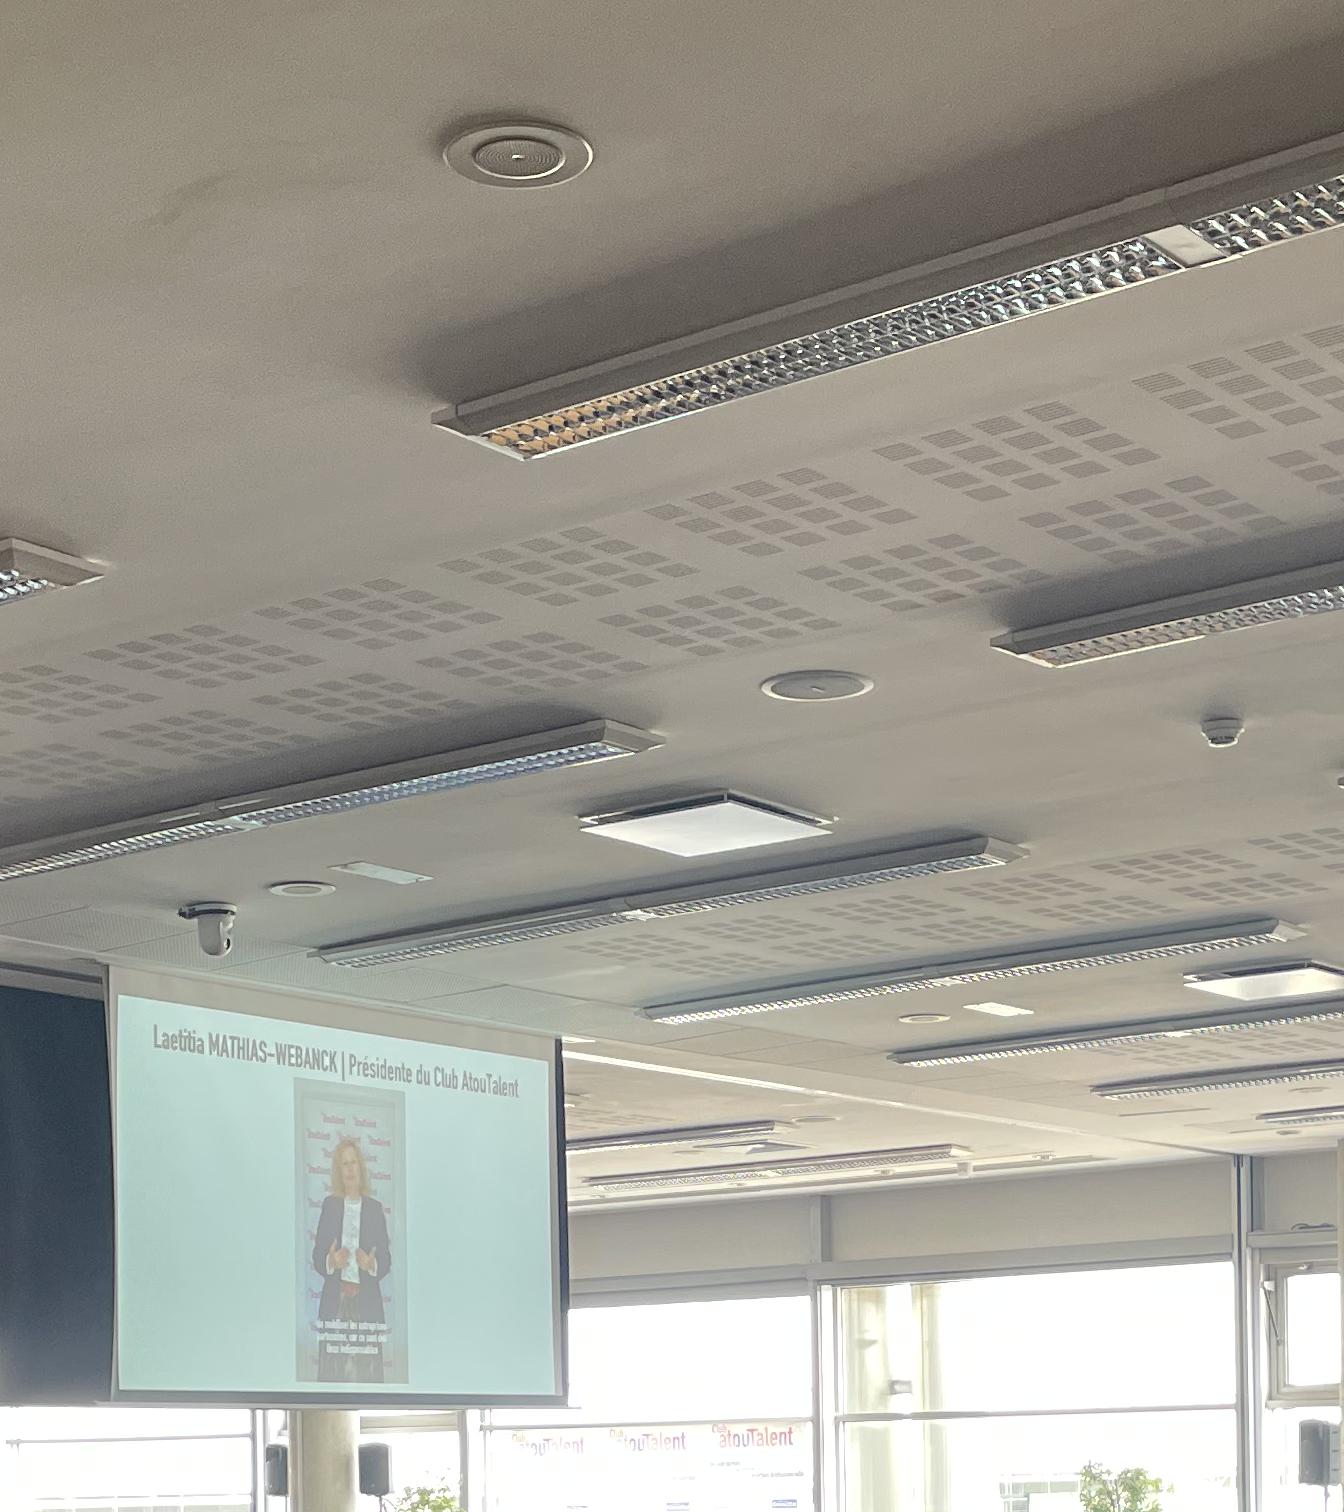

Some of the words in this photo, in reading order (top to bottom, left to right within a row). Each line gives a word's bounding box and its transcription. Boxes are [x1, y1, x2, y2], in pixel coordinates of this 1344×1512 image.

[153, 1023, 205, 1055] Laetitia
[208, 1031, 338, 1074] MATHIAS-WEBANCK
[348, 1053, 413, 1084] Présidente
[416, 1063, 431, 1087] du
[433, 1066, 458, 1090] Club
[461, 1070, 520, 1099] AtouTalent
[718, 1426, 795, 1448] atouTalent
